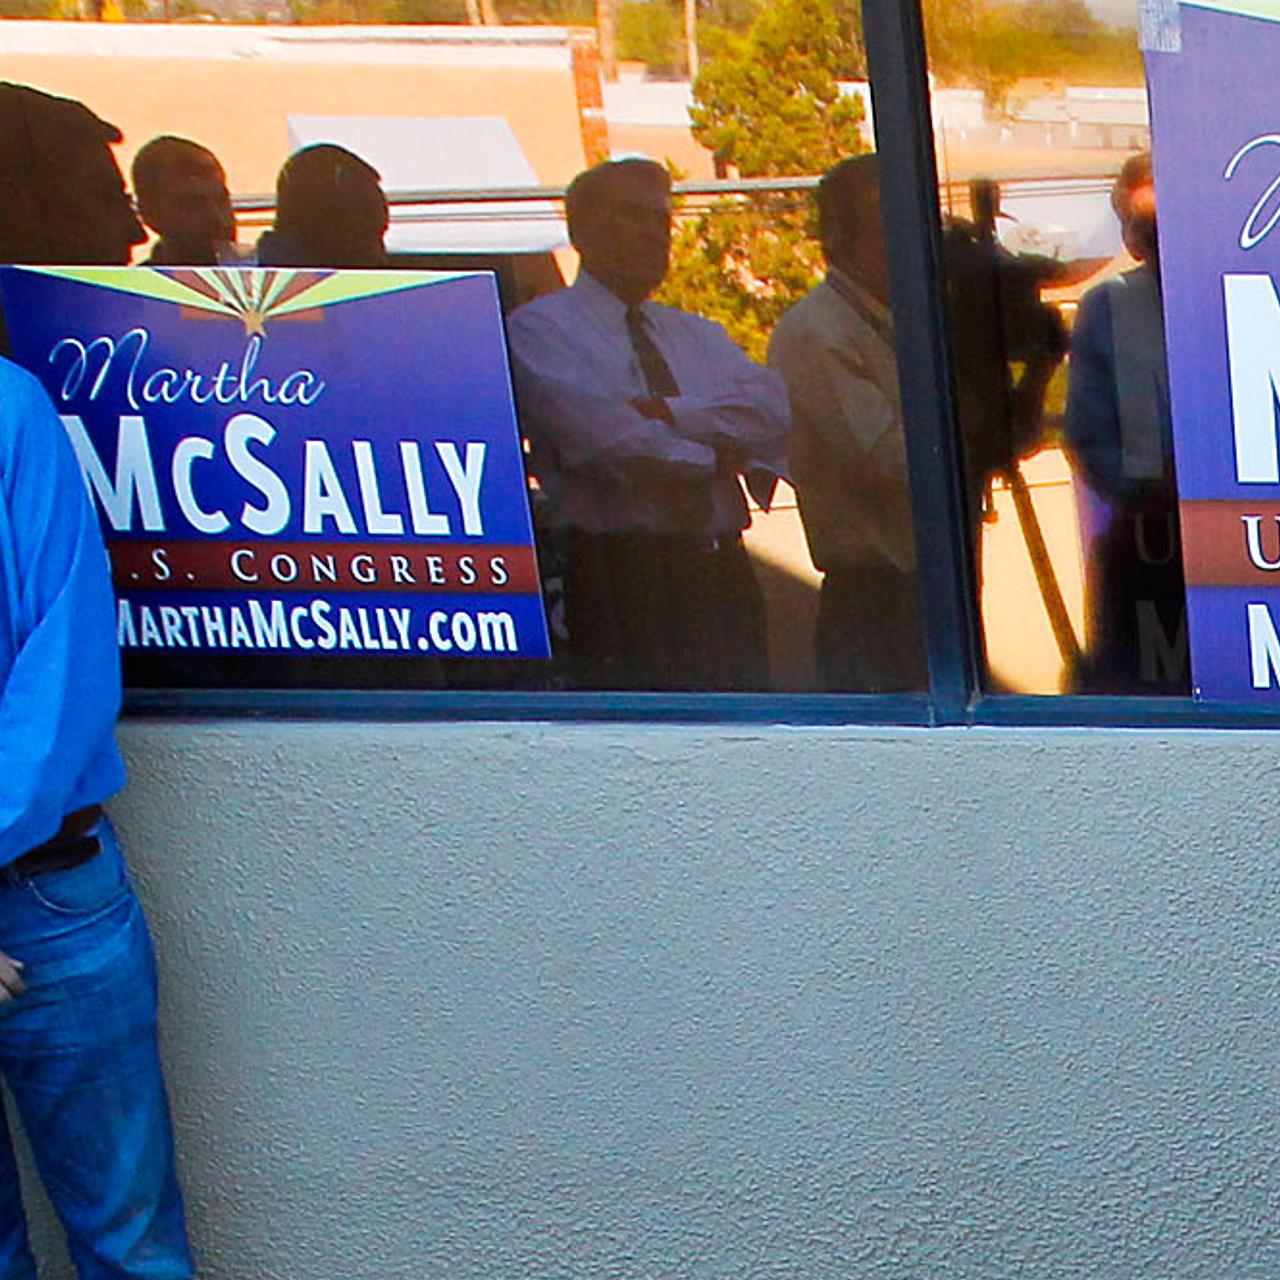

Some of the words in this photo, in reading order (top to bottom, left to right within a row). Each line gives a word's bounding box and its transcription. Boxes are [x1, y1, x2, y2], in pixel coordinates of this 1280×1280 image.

[48, 327, 327, 410] Martha
[128, 548, 196, 581] .S.
[230, 548, 511, 585] CONGRESS
